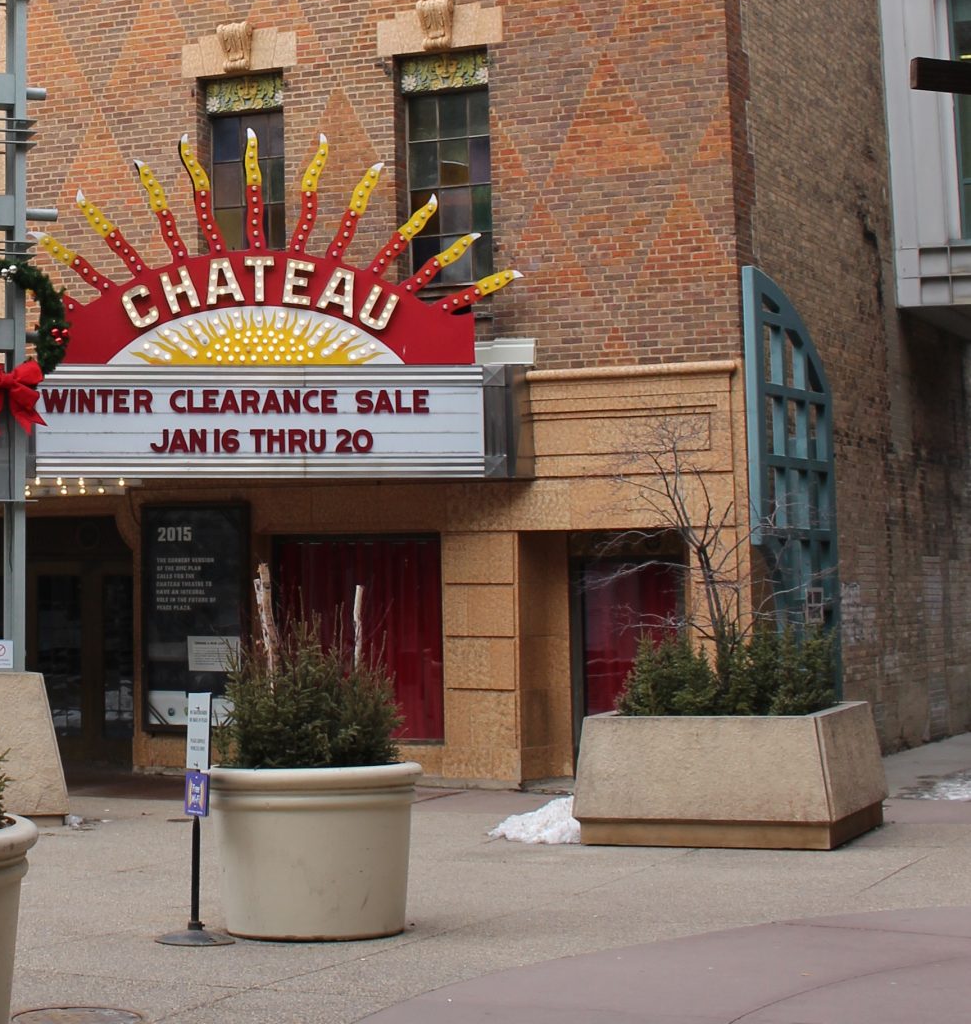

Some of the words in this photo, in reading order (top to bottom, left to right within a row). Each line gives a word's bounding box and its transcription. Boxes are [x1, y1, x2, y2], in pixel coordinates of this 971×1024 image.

[121, 256, 399, 331] CHATEAU
[41, 389, 153, 413] WINTER
[170, 389, 338, 413] CLEARANCE
[355, 389, 430, 413] SALE
[150, 429, 211, 453] JAN
[213, 429, 240, 453] 16
[249, 429, 326, 453] THRU
[336, 429, 373, 453] 20
[157, 526, 192, 542] 2015
